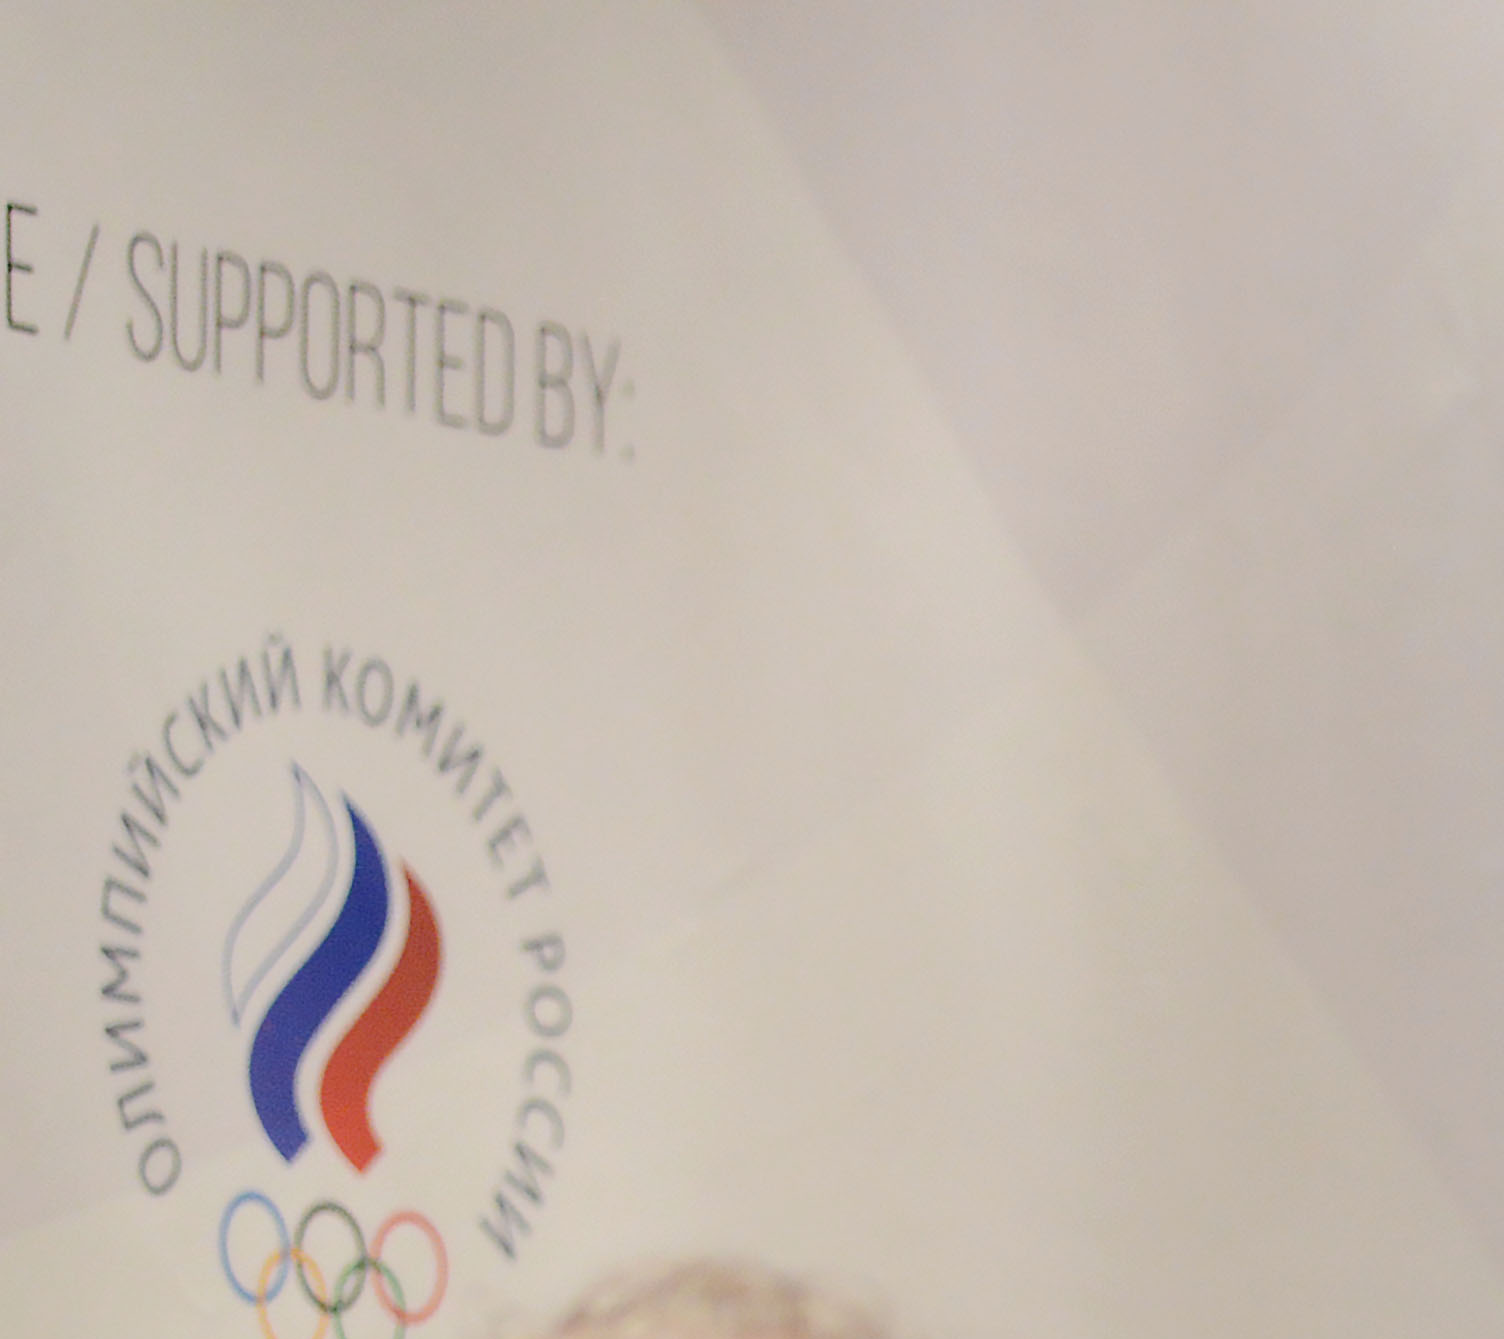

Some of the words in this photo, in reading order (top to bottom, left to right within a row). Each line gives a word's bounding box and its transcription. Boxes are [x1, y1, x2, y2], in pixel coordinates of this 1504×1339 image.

[126, 230, 517, 438] SUPPORTED
[536, 320, 638, 464] BY:
[100, 632, 303, 1198] ОЛИМПИЙСКИЙ
[321, 642, 554, 905] КОМИТЕТ
[477, 932, 576, 1264] РОССИИ
